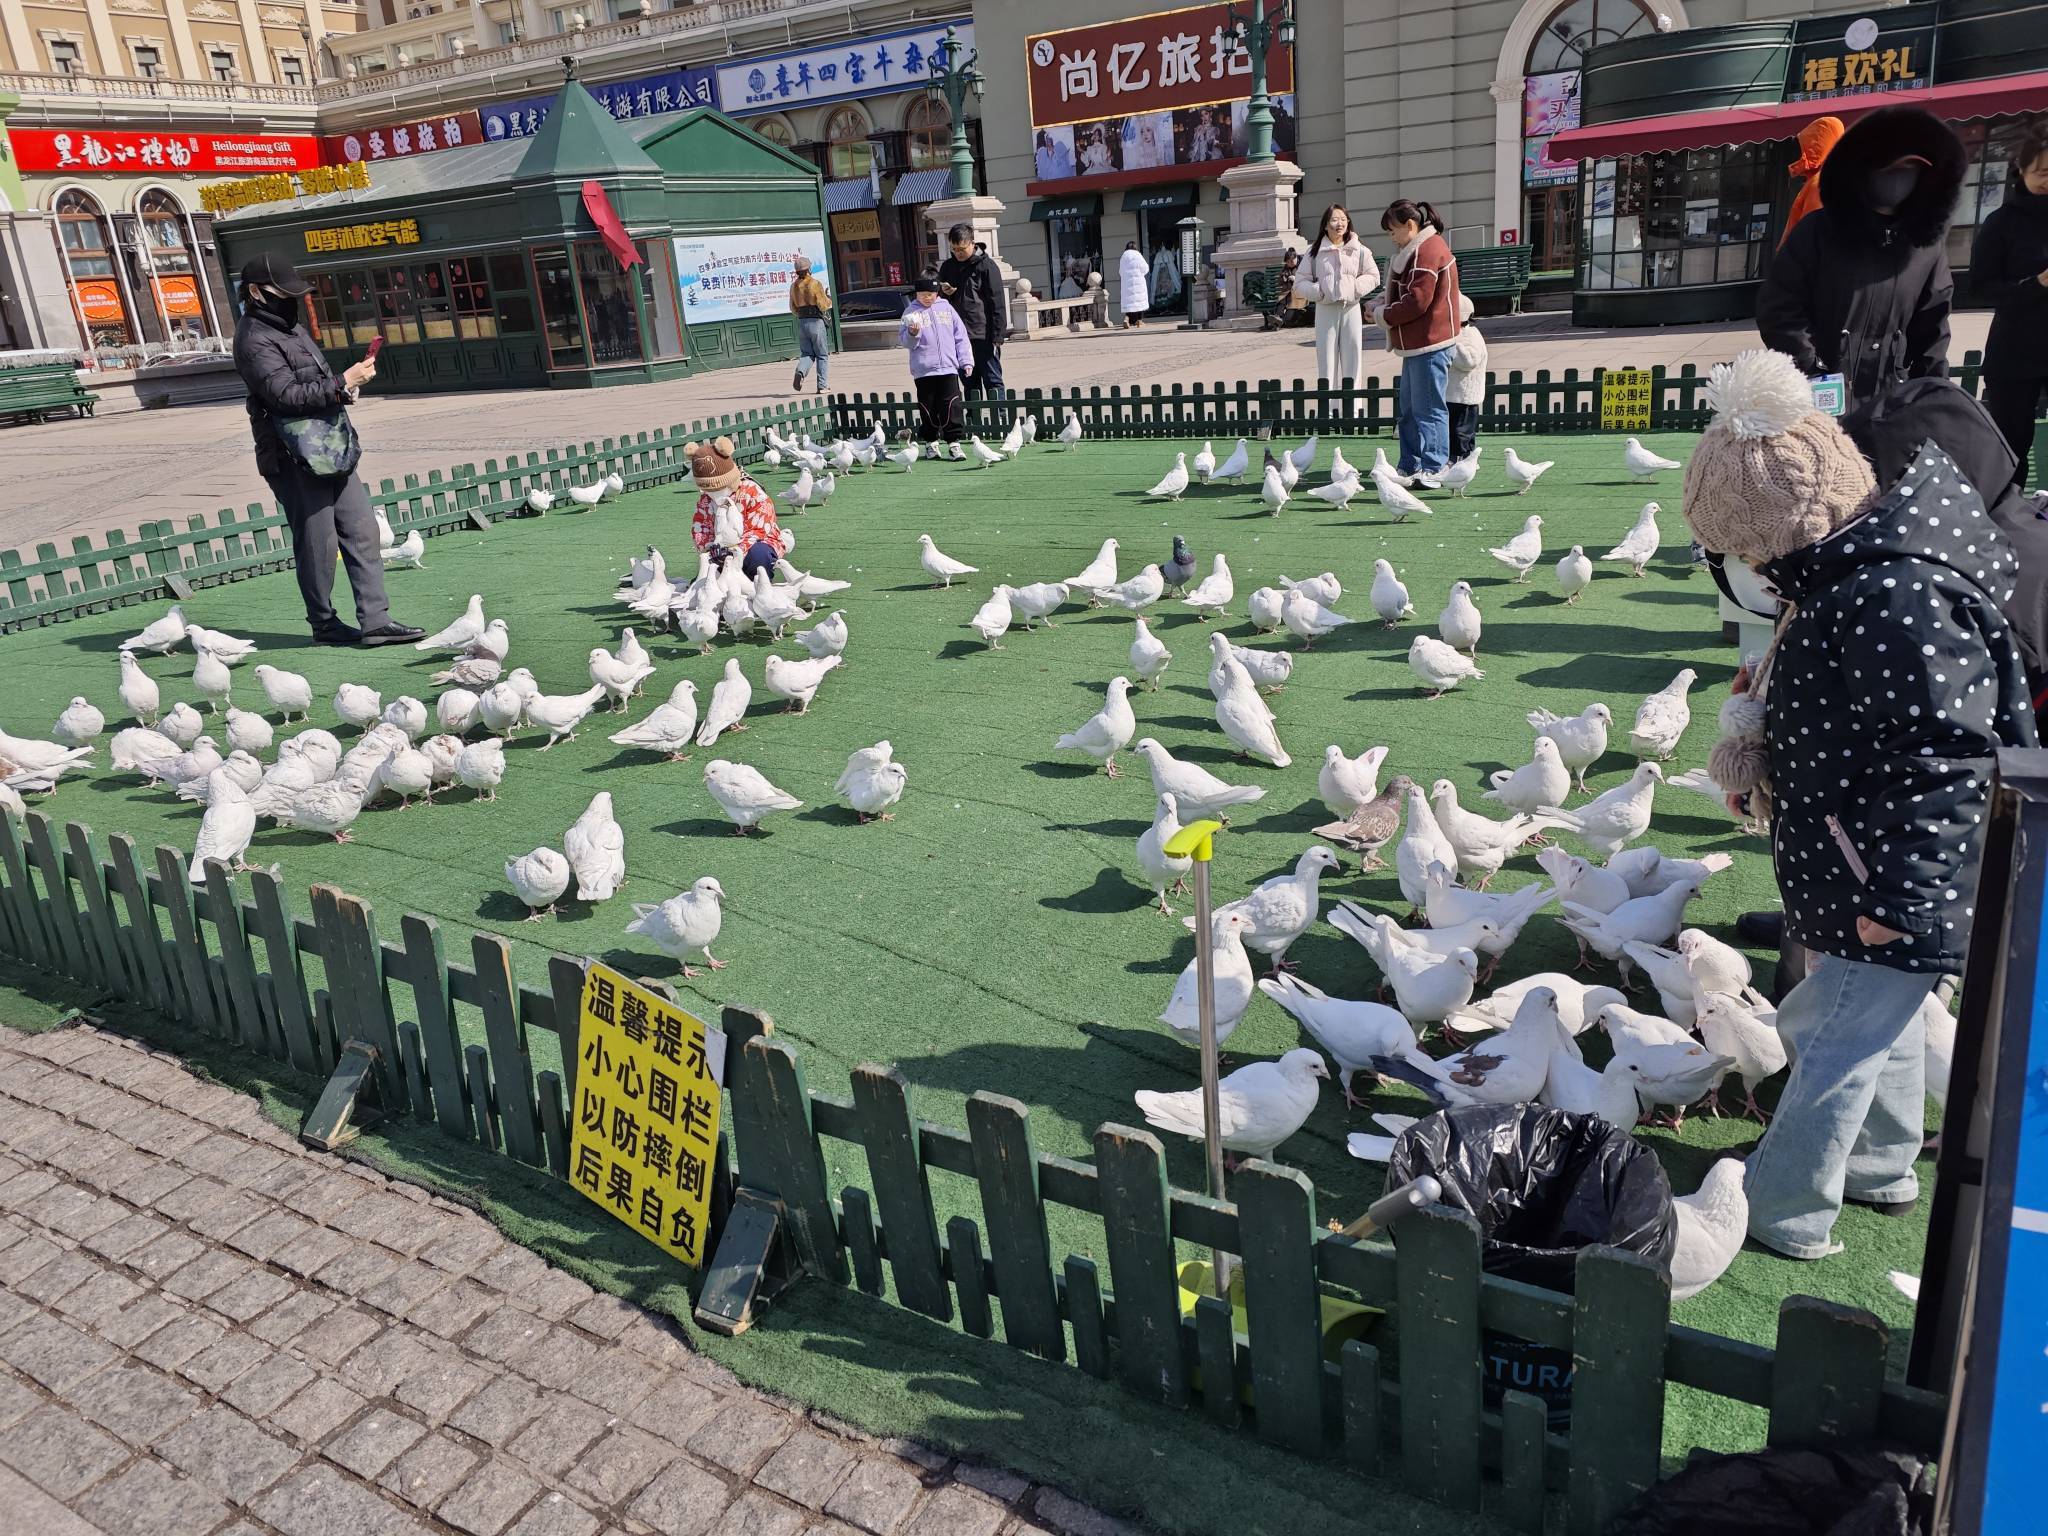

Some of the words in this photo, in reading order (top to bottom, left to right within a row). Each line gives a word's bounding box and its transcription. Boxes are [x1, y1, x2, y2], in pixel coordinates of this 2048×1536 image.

[1804, 46, 1916, 91] 禧欢礼
[212, 140, 272, 154] Heilongjiang
[273, 142, 293, 152] Gift
[304, 218, 420, 253] 四季沐歌空气能
[1603, 388, 1650, 401] 小心围栏
[1604, 373, 1651, 386] 温馨提示
[1603, 404, 1649, 417] 以防摔倒
[587, 972, 714, 1082] 温馨提示
[584, 1034, 714, 1147] 小心围栏
[580, 1087, 707, 1203] 以防摔倒
[575, 1144, 697, 1259] 后果自负
